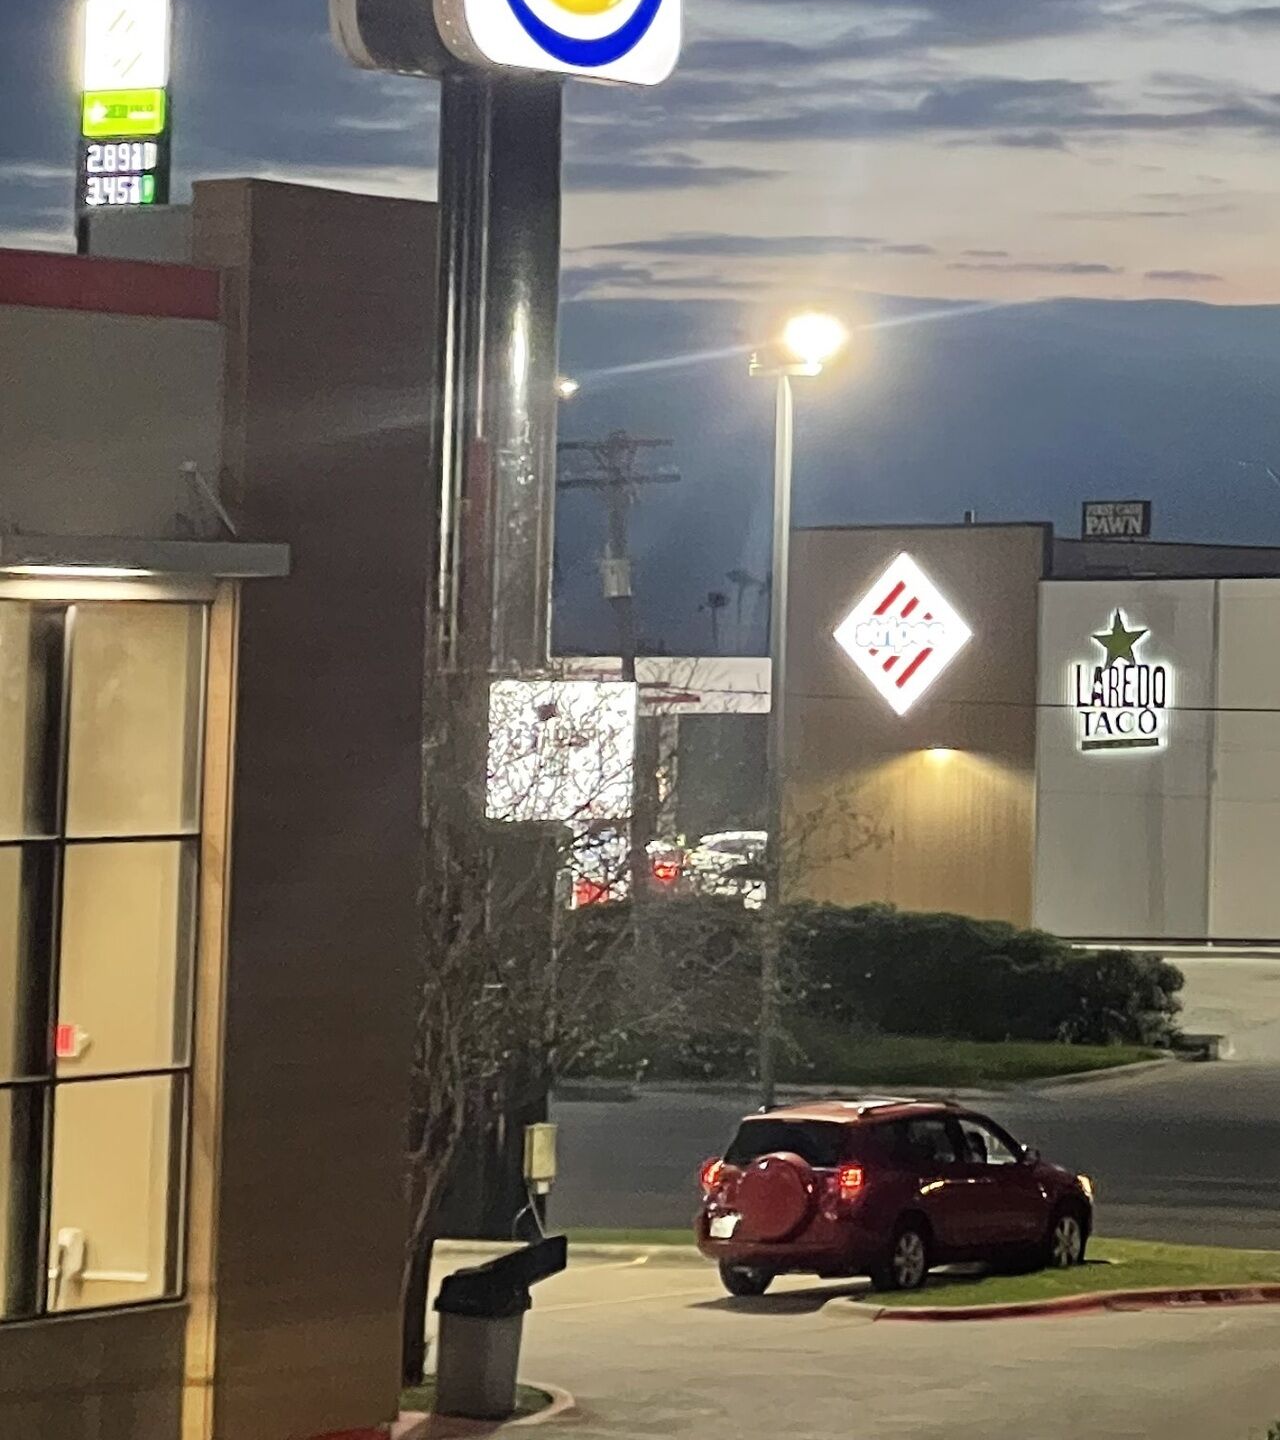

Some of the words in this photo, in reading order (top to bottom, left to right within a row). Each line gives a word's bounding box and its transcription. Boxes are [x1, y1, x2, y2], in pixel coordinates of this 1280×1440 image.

[1086, 515, 1143, 535] PAWN
[1076, 664, 1166, 708] LAREDO
[1079, 709, 1157, 736] TACO
